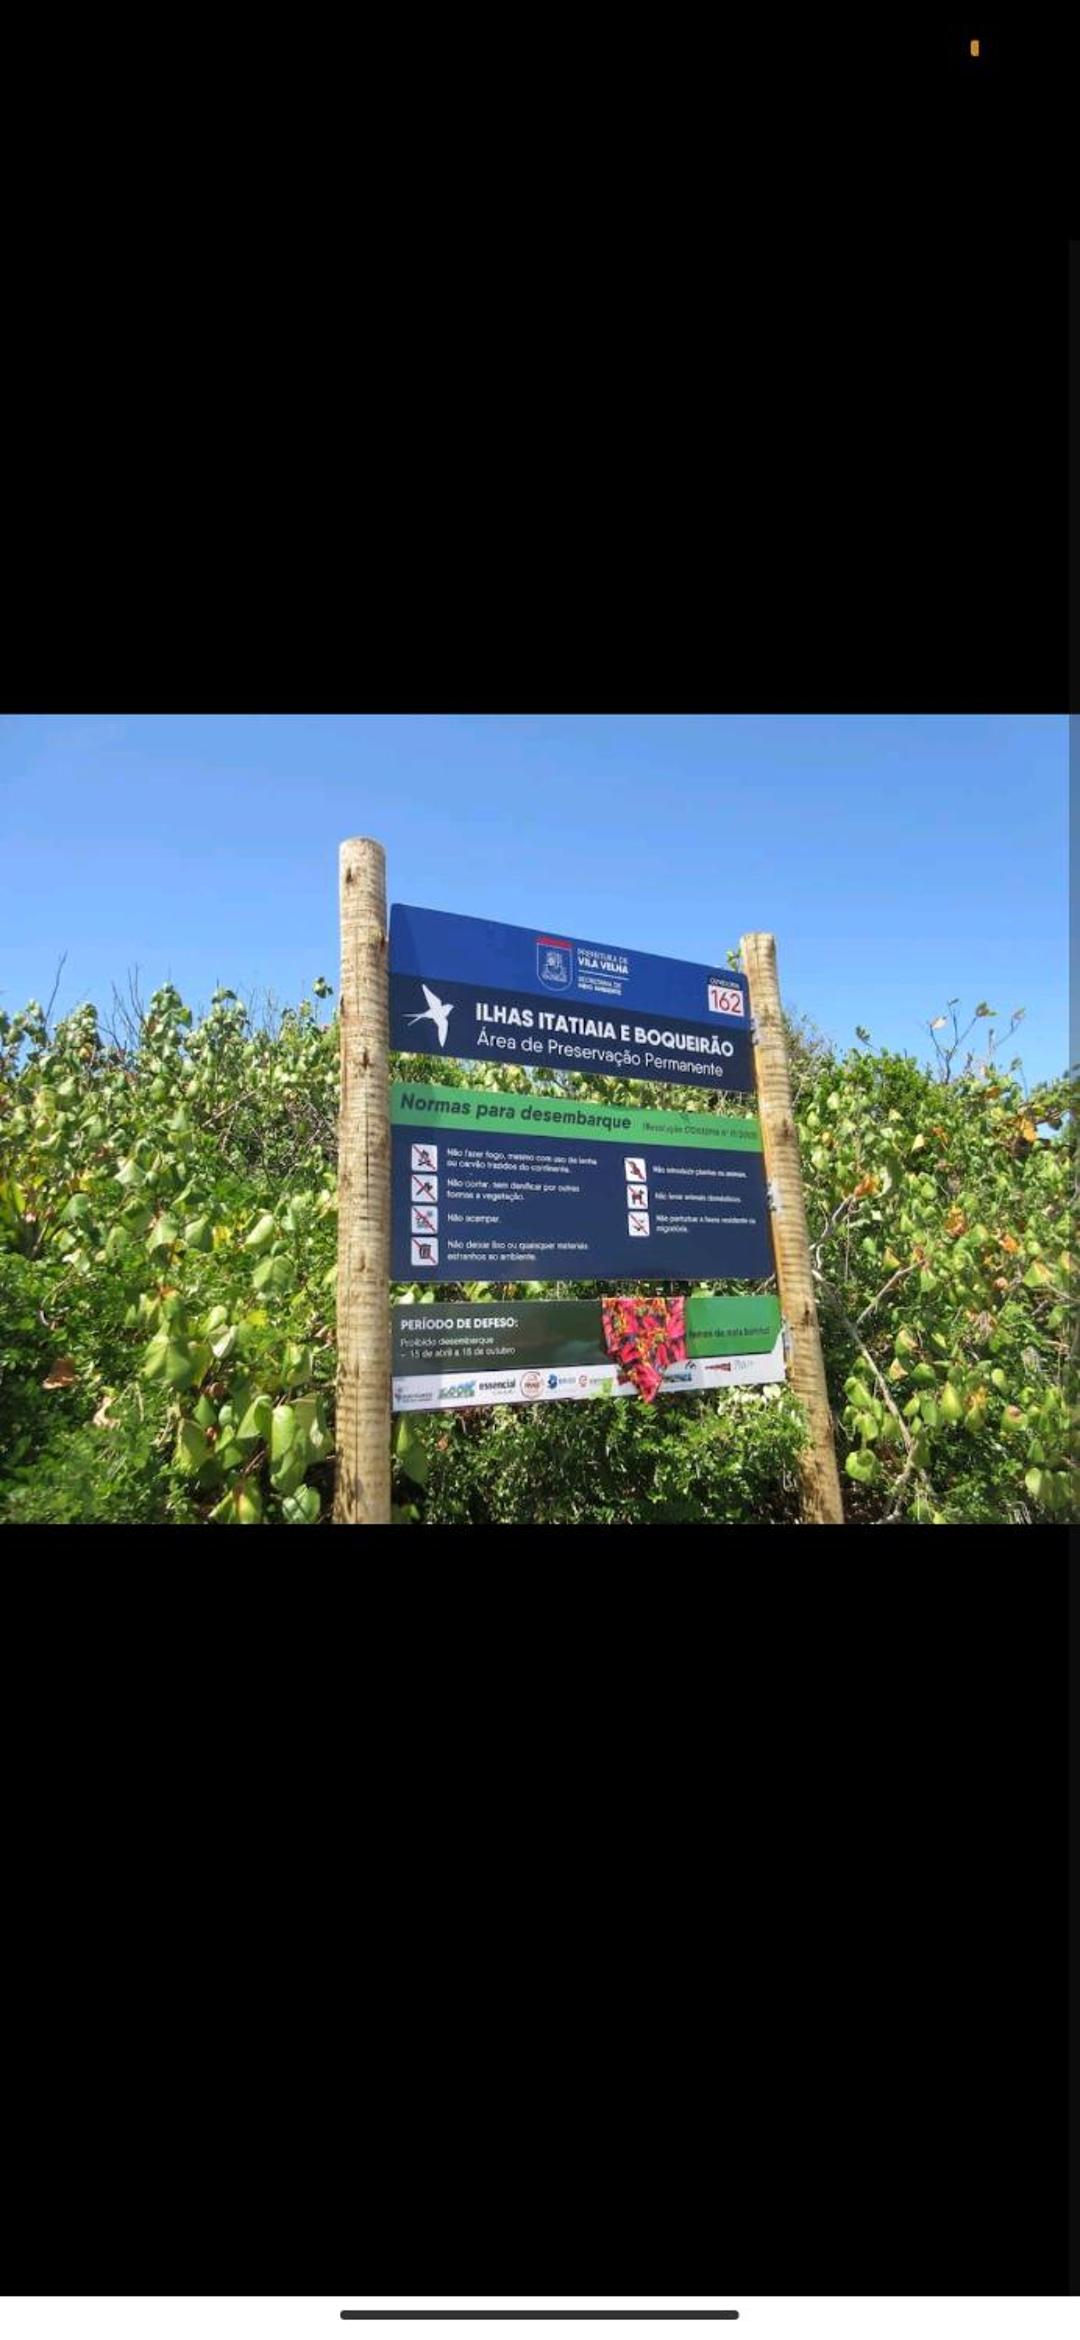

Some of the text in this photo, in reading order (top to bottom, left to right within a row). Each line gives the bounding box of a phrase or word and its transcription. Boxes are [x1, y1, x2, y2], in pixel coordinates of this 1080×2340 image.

[578, 956, 629, 974] VILA VELHA
[711, 989, 741, 1013] 162
[476, 1003, 735, 1057] ILHAS ITATIAIA E BOQUEIRÃO
[477, 1026, 724, 1077] Área de Preservação Permanente
[400, 1093, 631, 1131] Normas para desembarque
[447, 1148, 463, 1157] Não
[465, 1149, 483, 1158] fazer
[485, 1150, 506, 1160] fogo,
[507, 1153, 535, 1162] mesmo
[536, 1155, 552, 1163] com
[579, 1156, 598, 1165] lenha
[459, 1160, 485, 1169] carvão
[487, 1160, 517, 1171] trazidos
[519, 1162, 530, 1171] do
[447, 1179, 463, 1188] Não
[510, 1181, 542, 1191] danificar
[543, 1184, 556, 1192] por
[558, 1184, 580, 1192] outras
[446, 1189, 473, 1199] formas
[482, 1191, 524, 1202] vegetação.
[447, 1213, 502, 1224] Não acampar.
[447, 1240, 464, 1249] Não
[466, 1240, 489, 1249] deixar
[491, 1240, 506, 1249] lixo
[519, 1242, 555, 1251] quaisquer
[556, 1241, 588, 1250] materiais
[447, 1252, 487, 1261] estranhos
[400, 1316, 519, 1331] PERÍODO DE DEFESO:
[400, 1336, 494, 1347] Proibido desembarque
[421, 1349, 433, 1358] de
[434, 1348, 453, 1358] abril
[474, 1347, 485, 1356] de
[485, 1347, 516, 1356] outubro
[478, 1377, 516, 1391] essencial
